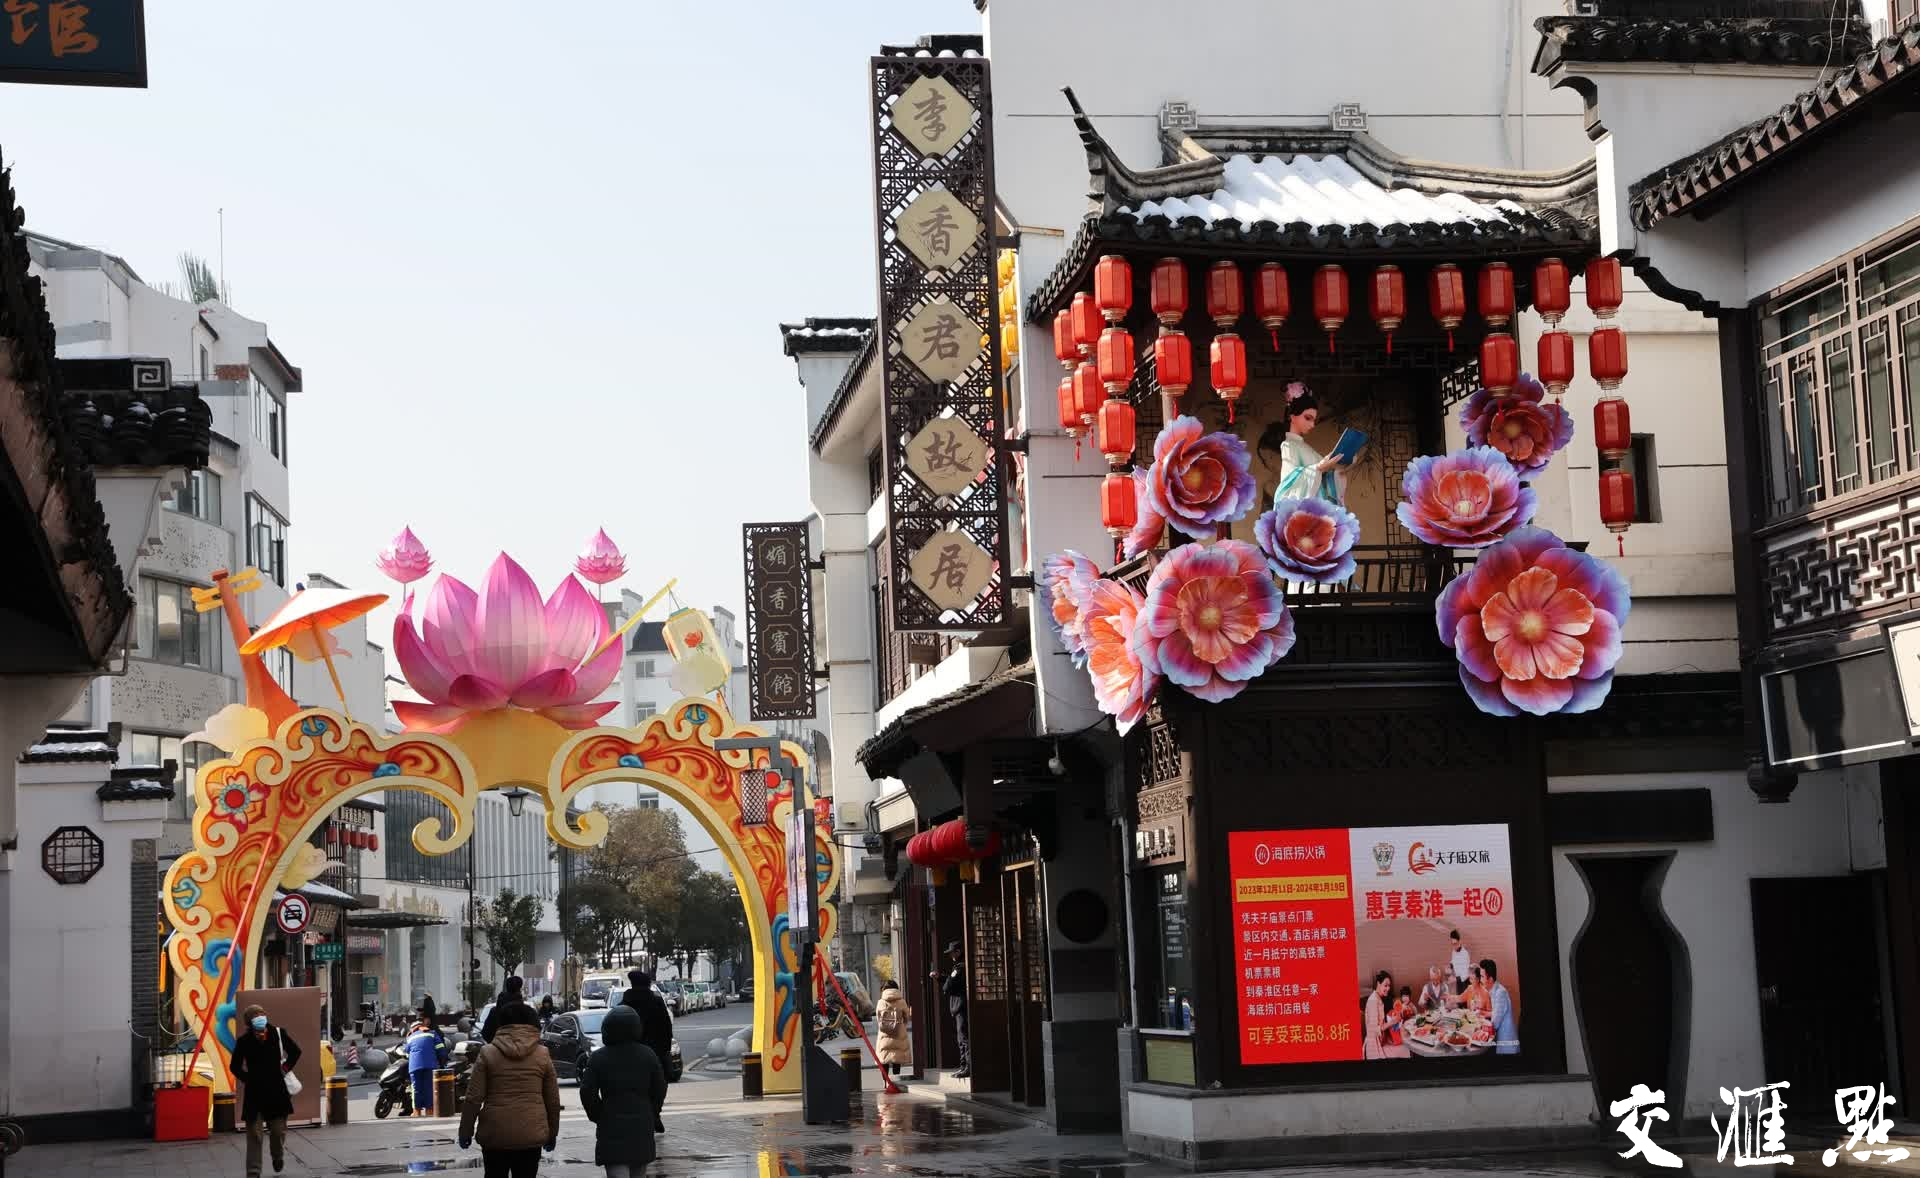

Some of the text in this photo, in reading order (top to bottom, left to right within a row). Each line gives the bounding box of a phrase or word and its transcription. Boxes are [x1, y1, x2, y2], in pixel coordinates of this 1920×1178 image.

[912, 87, 973, 590] 李香君故居
[1271, 845, 1326, 861] 海底捞火锅
[1365, 888, 1483, 920] 惠享秦淮一起
[1241, 910, 1314, 925] 凭夫子庙景点门票
[1243, 927, 1347, 943] 景区内交通、酒店消费记录
[1244, 946, 1326, 961] 近一月抵宁的高铁票
[1244, 966, 1281, 980] 机票票根
[1245, 983, 1319, 998] 到秦淮区任意一家
[1247, 1001, 1311, 1016] 海底捞门店用餐
[1247, 1023, 1351, 1046] 可享受菜品8.8折
